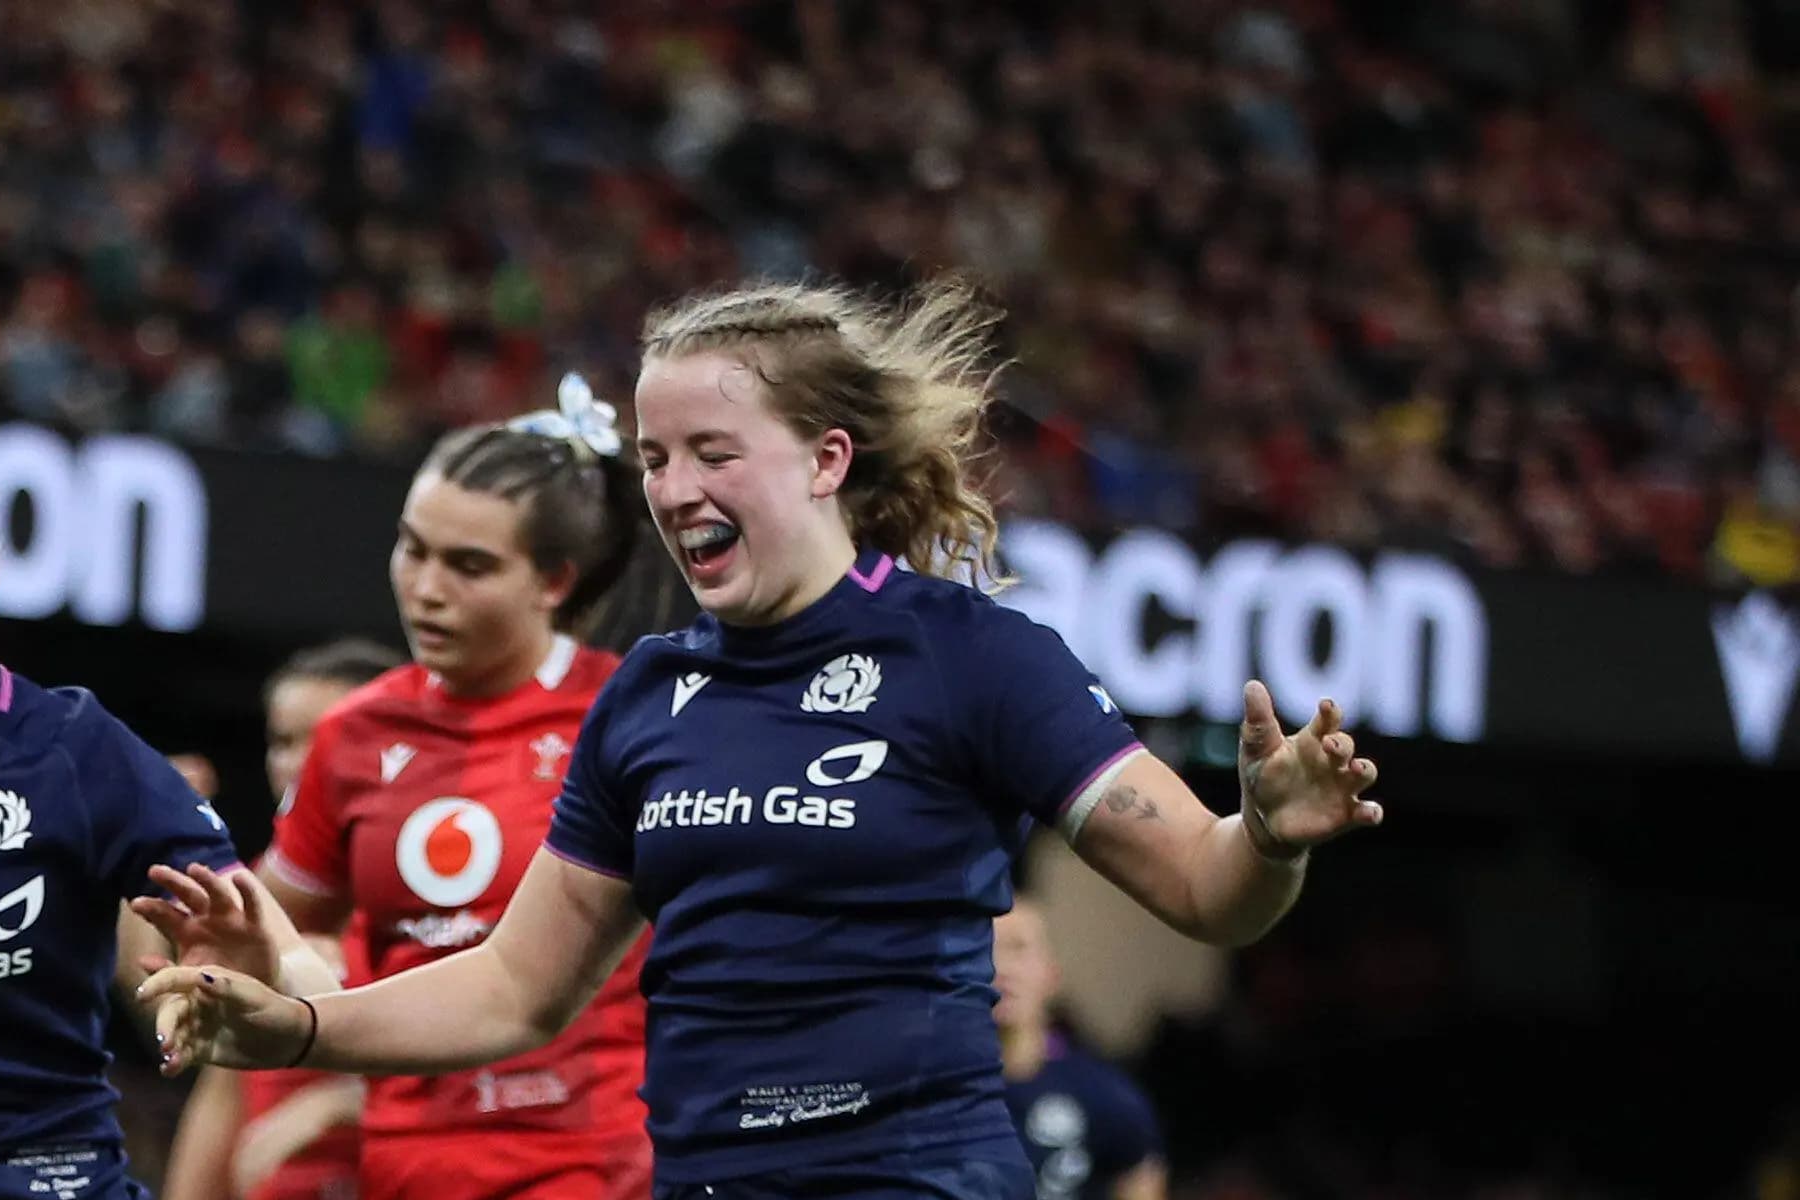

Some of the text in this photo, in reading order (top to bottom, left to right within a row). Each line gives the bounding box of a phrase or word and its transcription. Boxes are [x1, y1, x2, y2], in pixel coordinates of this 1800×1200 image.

[928, 518, 1487, 744] acron
[636, 786, 856, 833] ottish Gas
